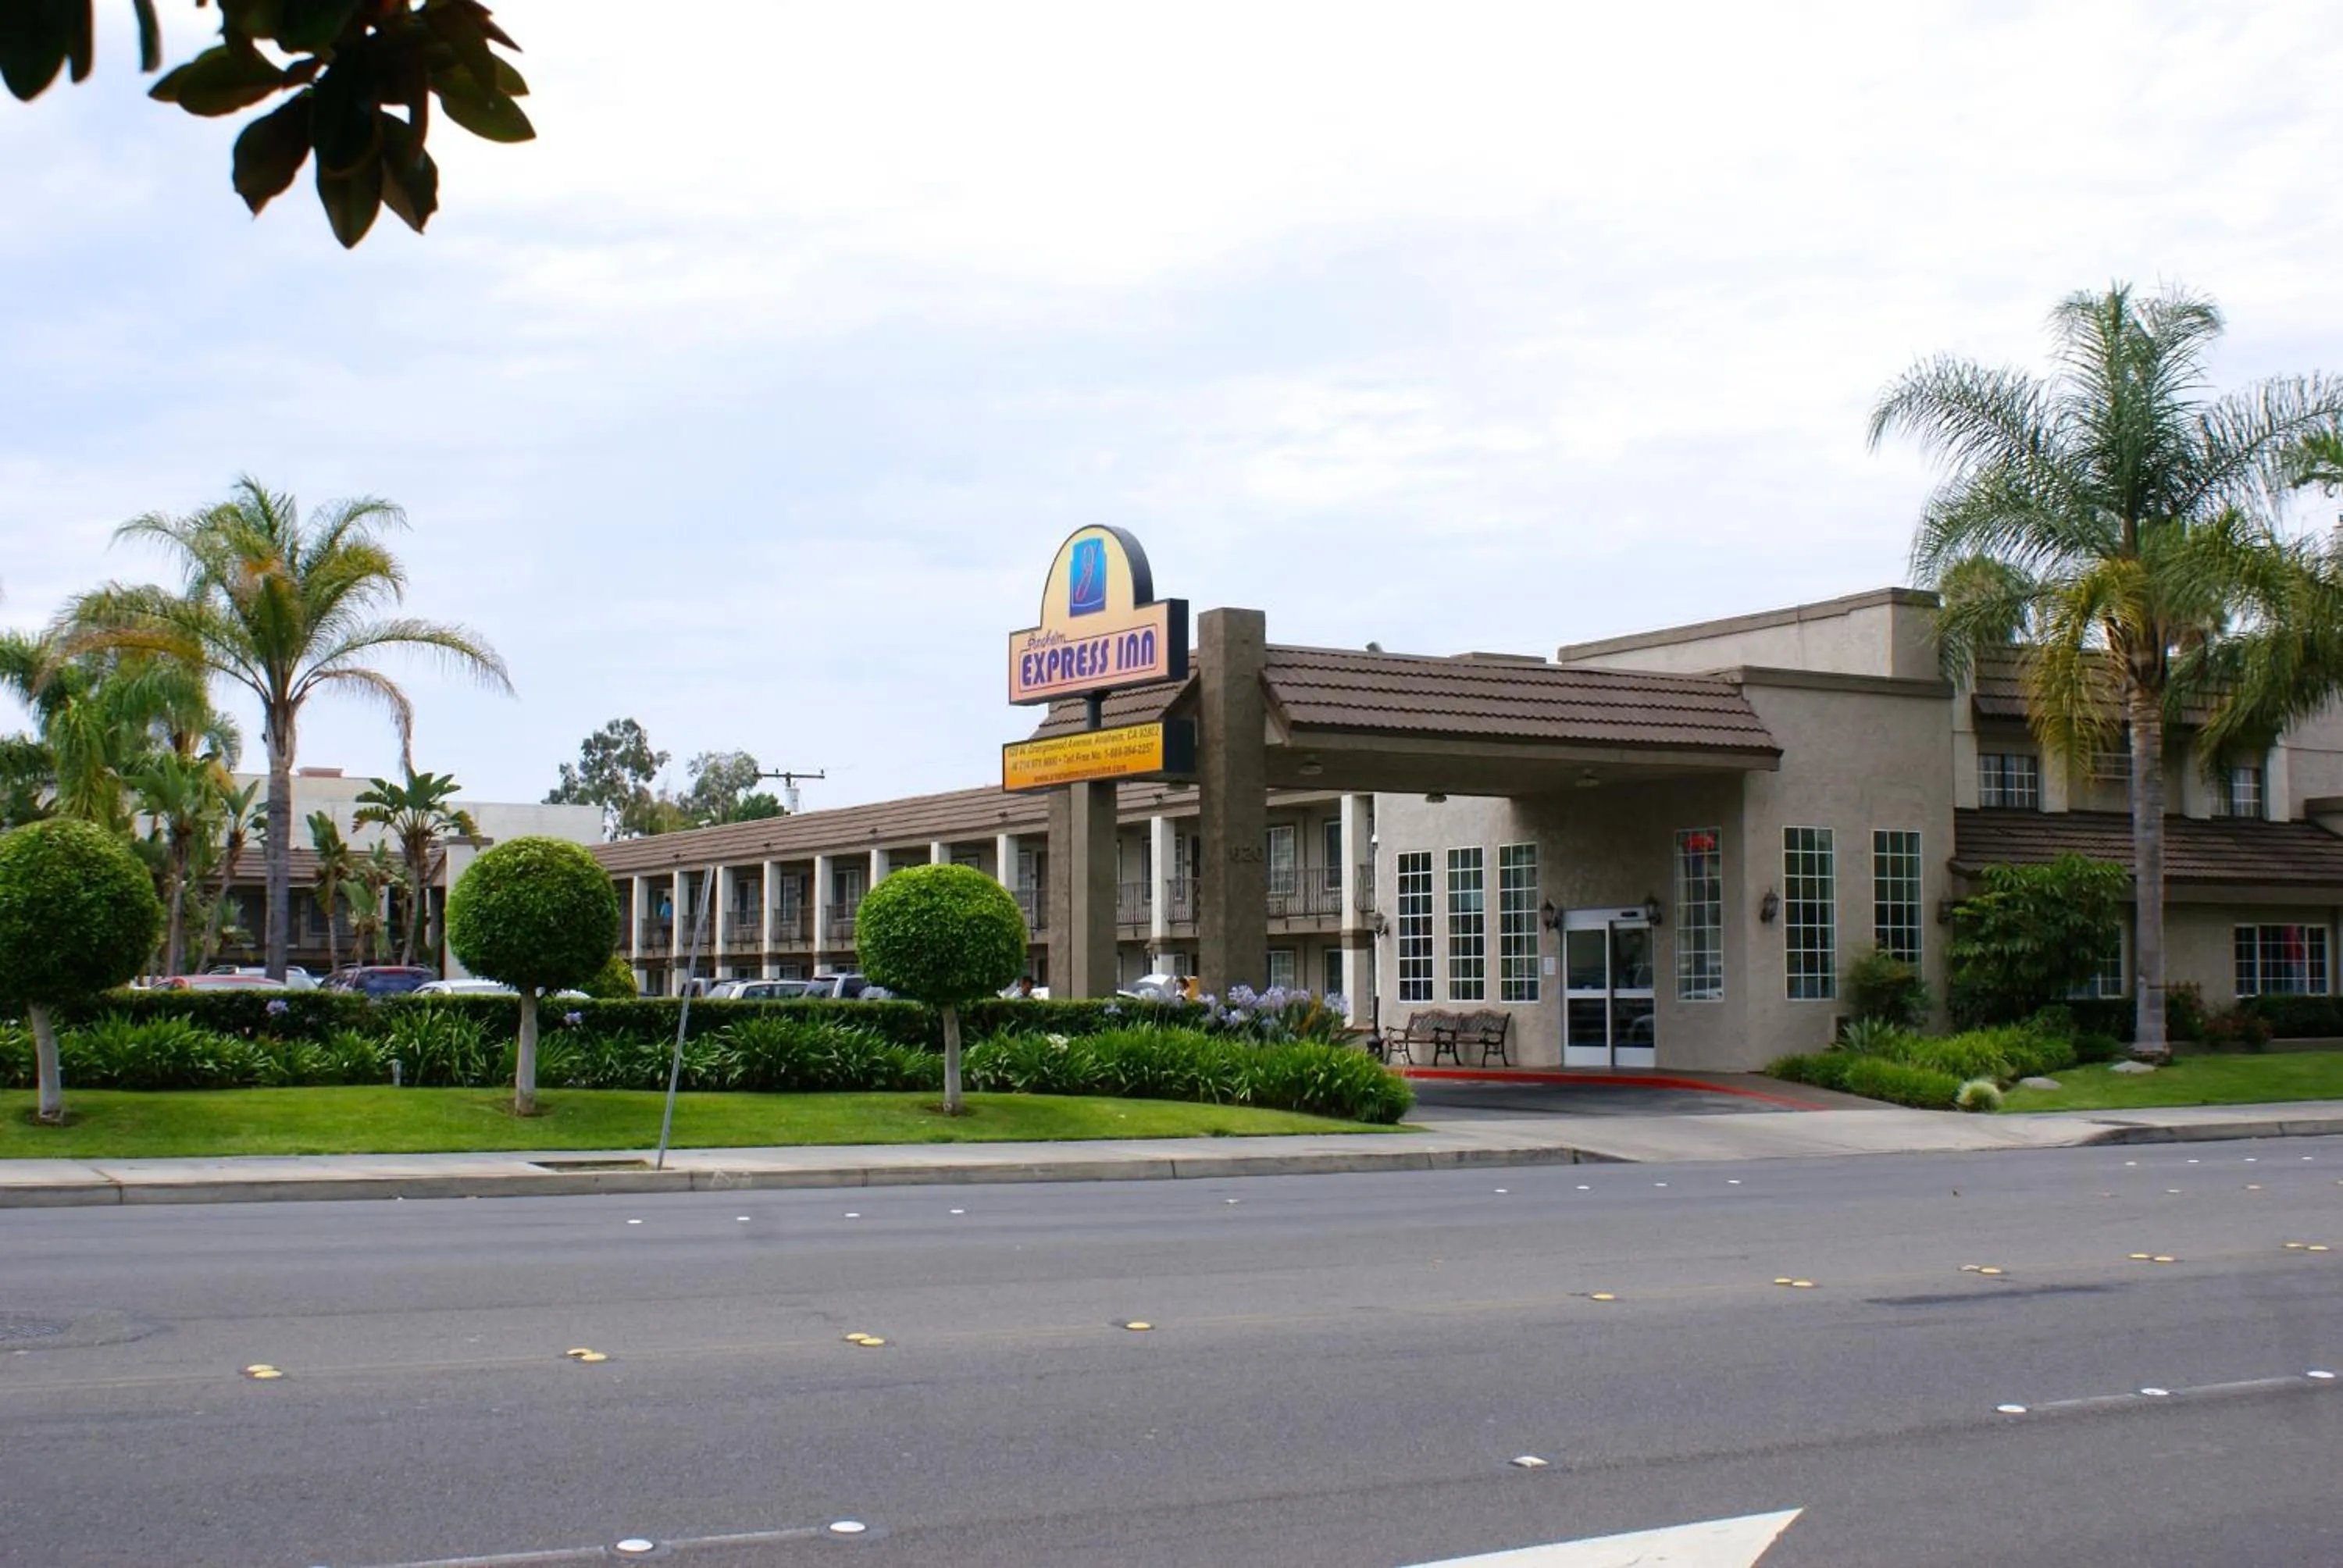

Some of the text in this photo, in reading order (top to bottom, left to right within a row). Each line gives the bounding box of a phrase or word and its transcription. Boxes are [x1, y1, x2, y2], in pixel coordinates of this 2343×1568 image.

[1022, 638, 1110, 686] EXPRESS
[1128, 728, 1137, 739] CA
[1075, 750, 1089, 761] Free
